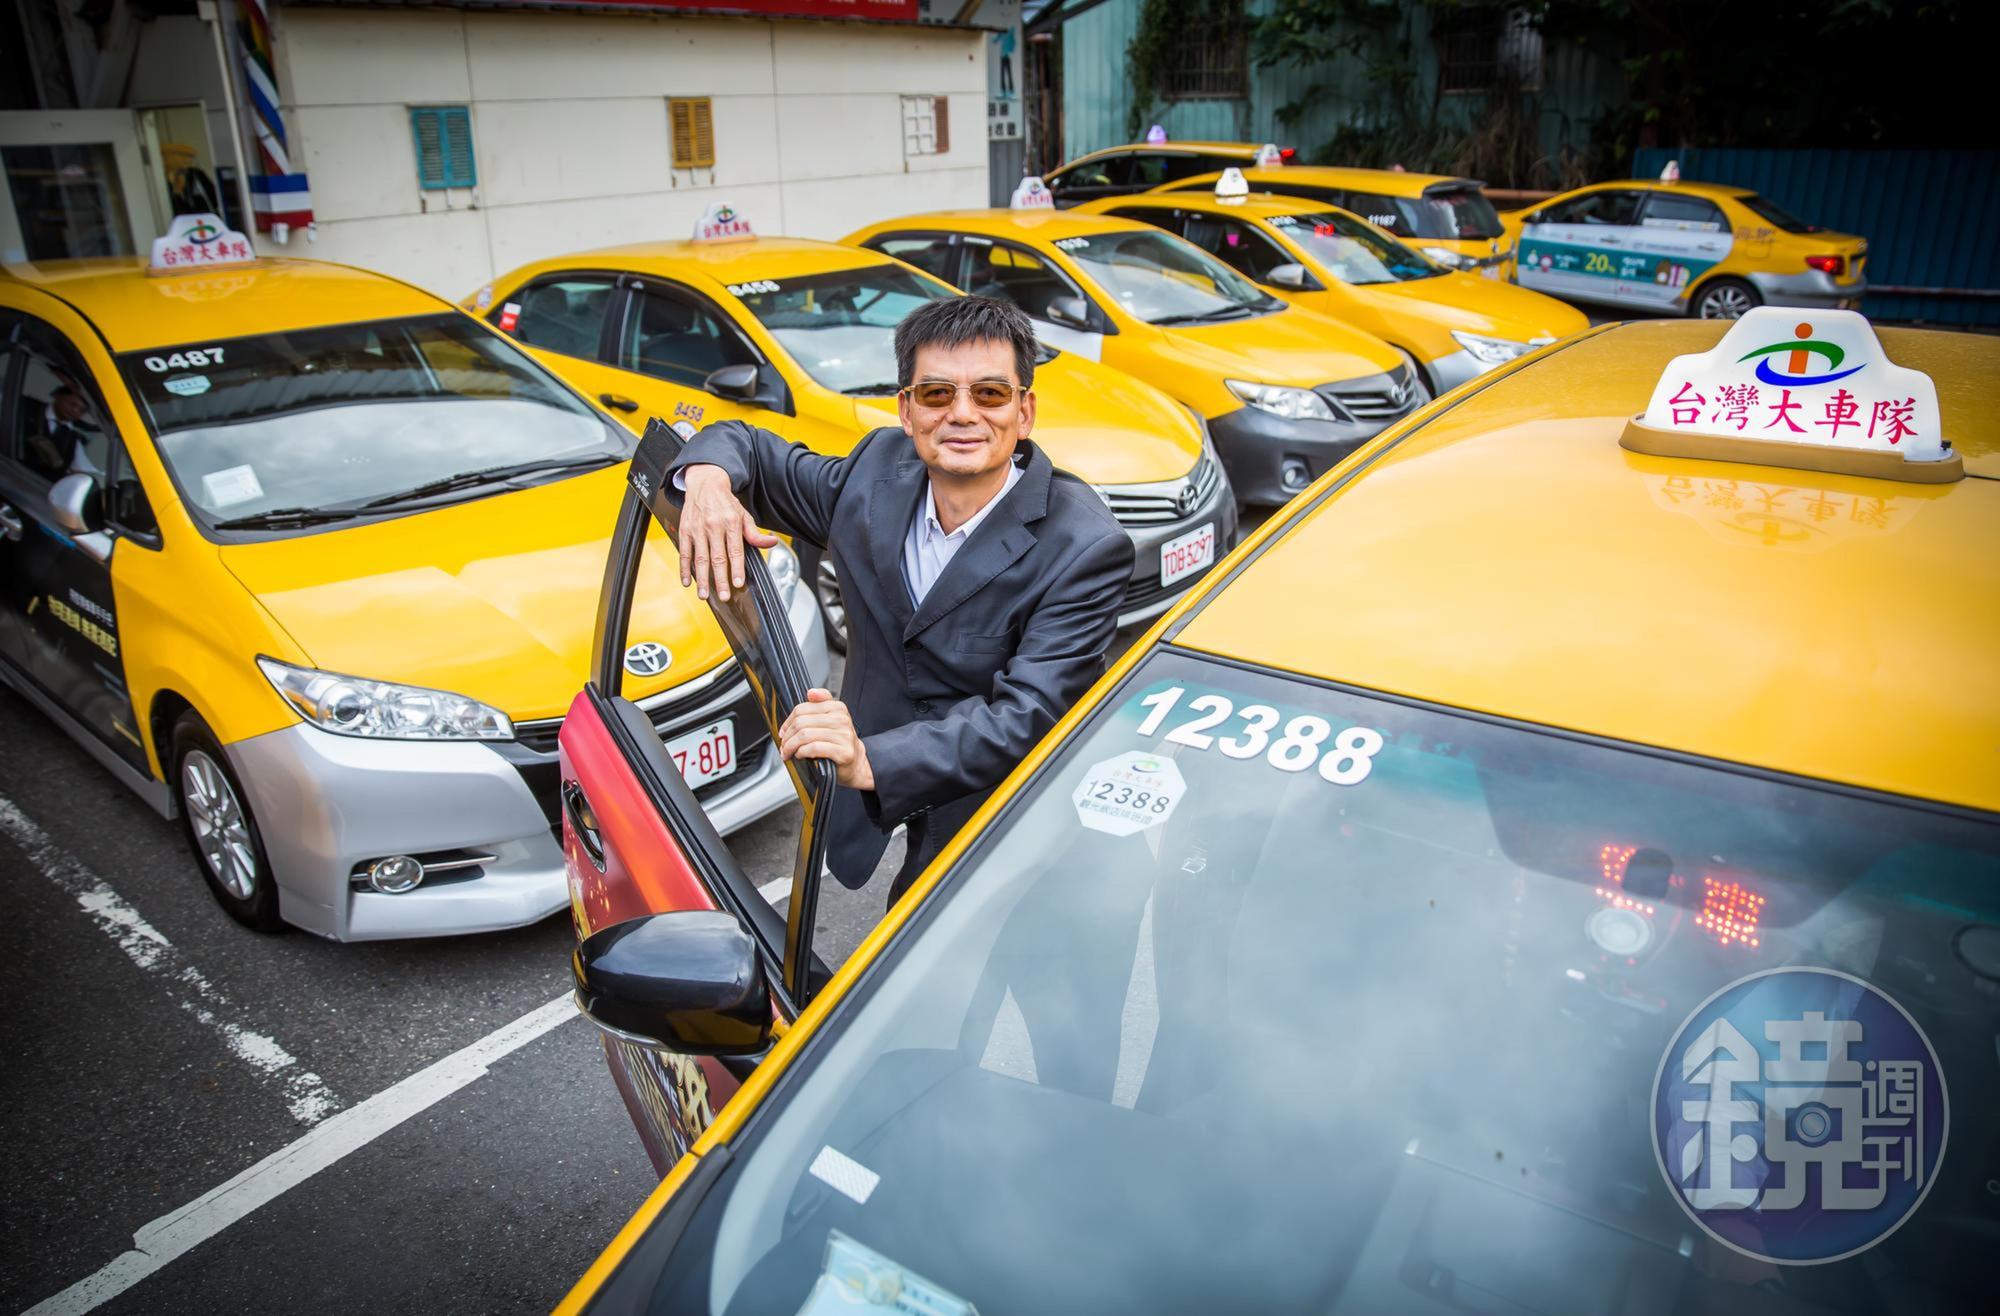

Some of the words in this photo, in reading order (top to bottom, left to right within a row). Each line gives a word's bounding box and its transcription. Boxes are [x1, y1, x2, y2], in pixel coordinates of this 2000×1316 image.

[162, 241, 248, 265] 台灣大車隊
[144, 347, 224, 373] 0487
[674, 402, 704, 422] 8458
[1668, 381, 1919, 445] 台灣大車隊
[1136, 686, 1384, 786] 12388
[1087, 780, 1171, 814] 12388
